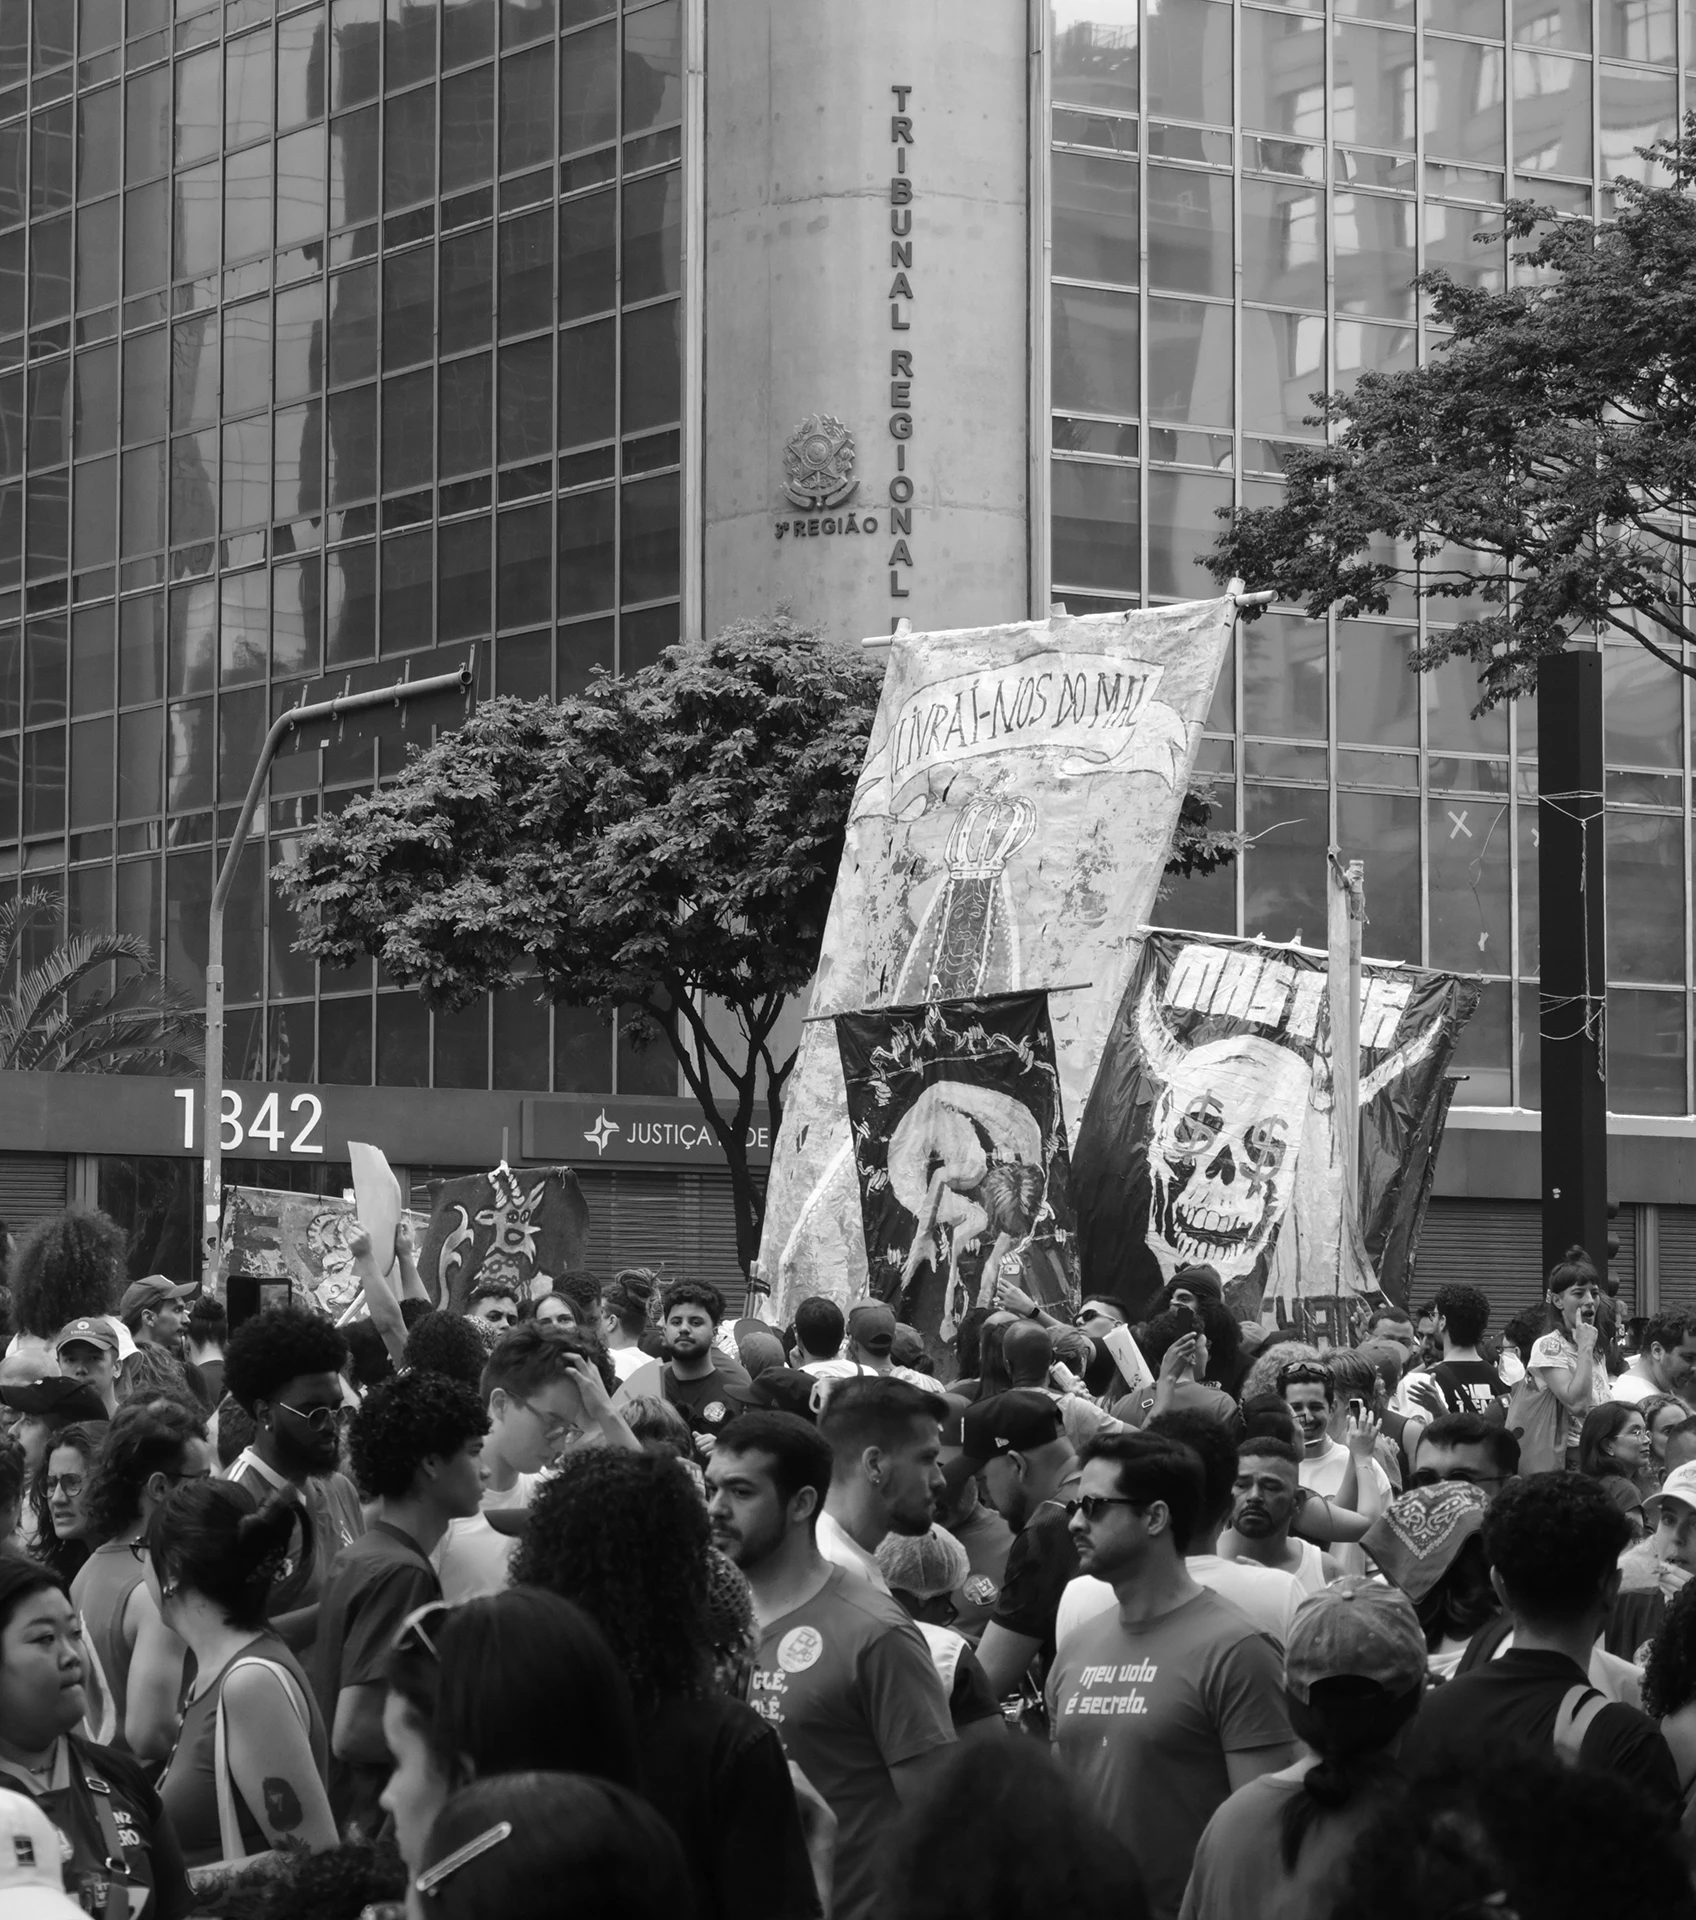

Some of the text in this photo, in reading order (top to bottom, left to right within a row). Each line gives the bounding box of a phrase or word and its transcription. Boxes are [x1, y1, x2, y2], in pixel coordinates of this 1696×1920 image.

[888, 85, 915, 331] TRIBUNAL
[888, 349, 915, 598] REGIONAL
[792, 512, 878, 537] REGIÃO
[173, 1088, 324, 1154] 1842
[626, 1122, 712, 1150] JUSTIÇA
[1079, 1656, 1158, 1690] meu voto
[1064, 1687, 1149, 1715] é secreto.
